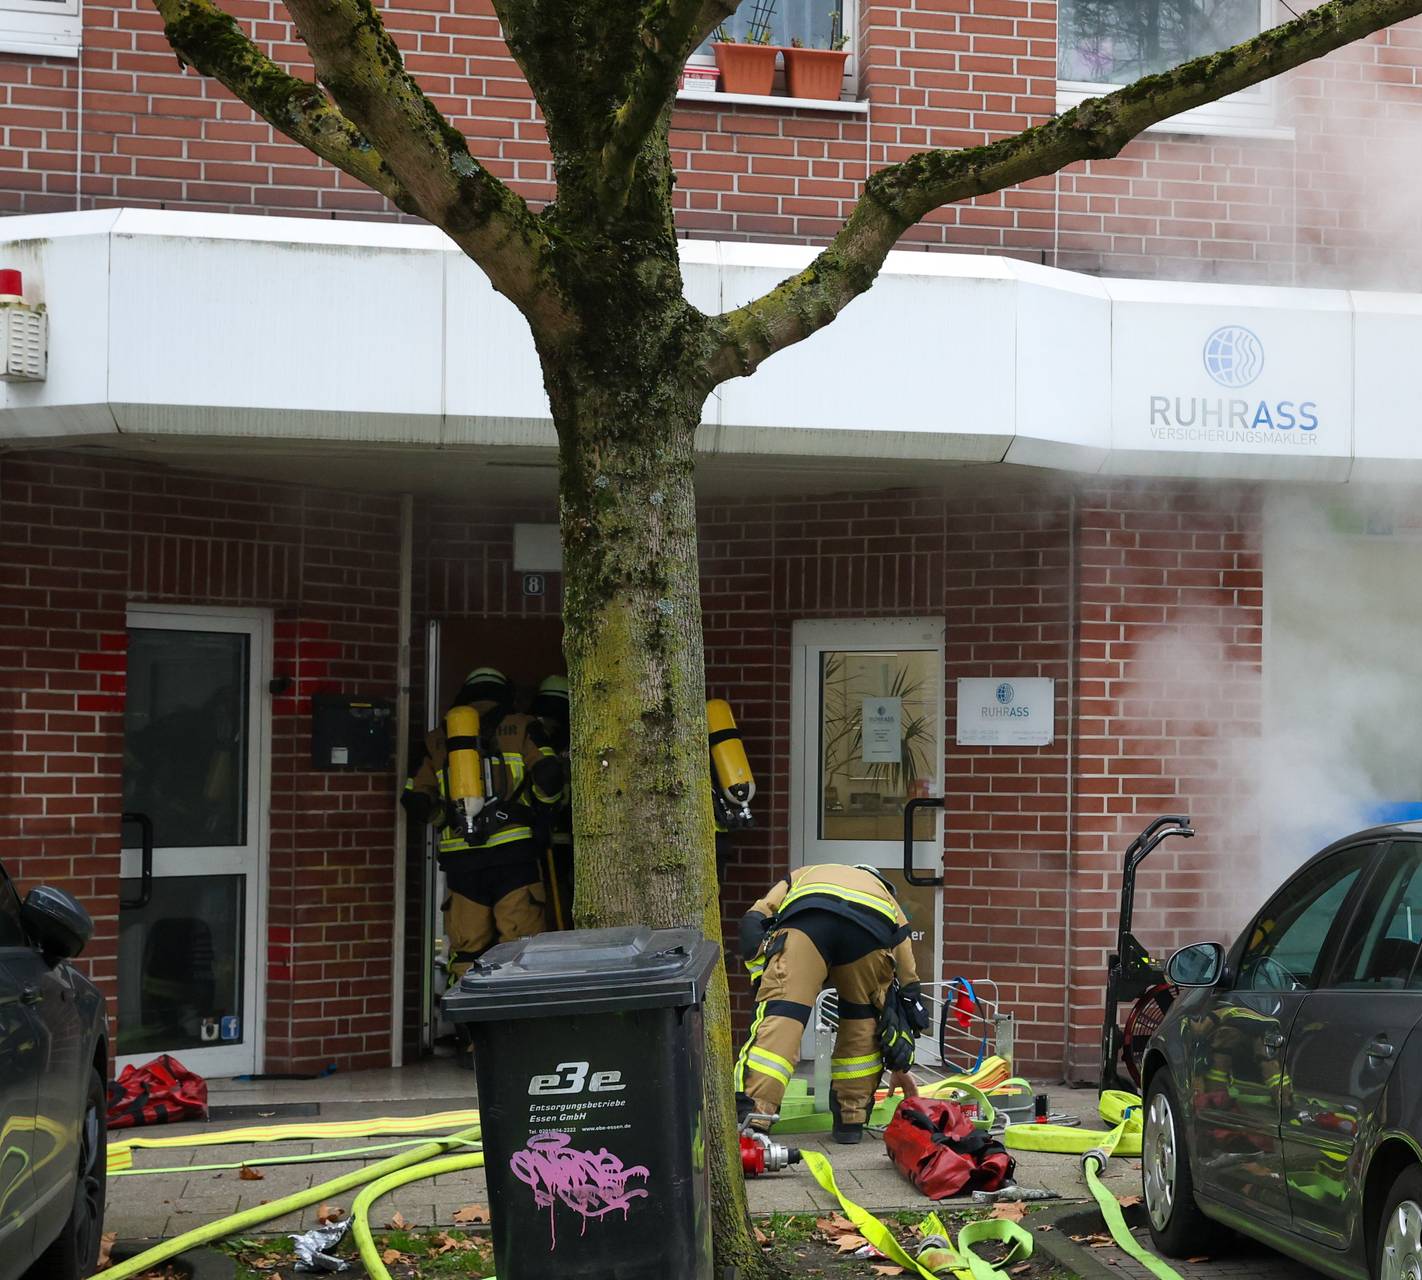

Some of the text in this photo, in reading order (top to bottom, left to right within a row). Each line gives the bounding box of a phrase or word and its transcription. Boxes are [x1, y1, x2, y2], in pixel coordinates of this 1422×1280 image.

[1149, 395, 1318, 431] RUHRASS
[1150, 427, 1318, 445] VERSICHERUNGSMAKLER
[528, 577, 539, 593] 8
[981, 706, 1029, 718] RUHRASS
[529, 1099, 626, 1112] Entsorgungsbetriebe
[529, 1112, 587, 1123] Essen GmbH
